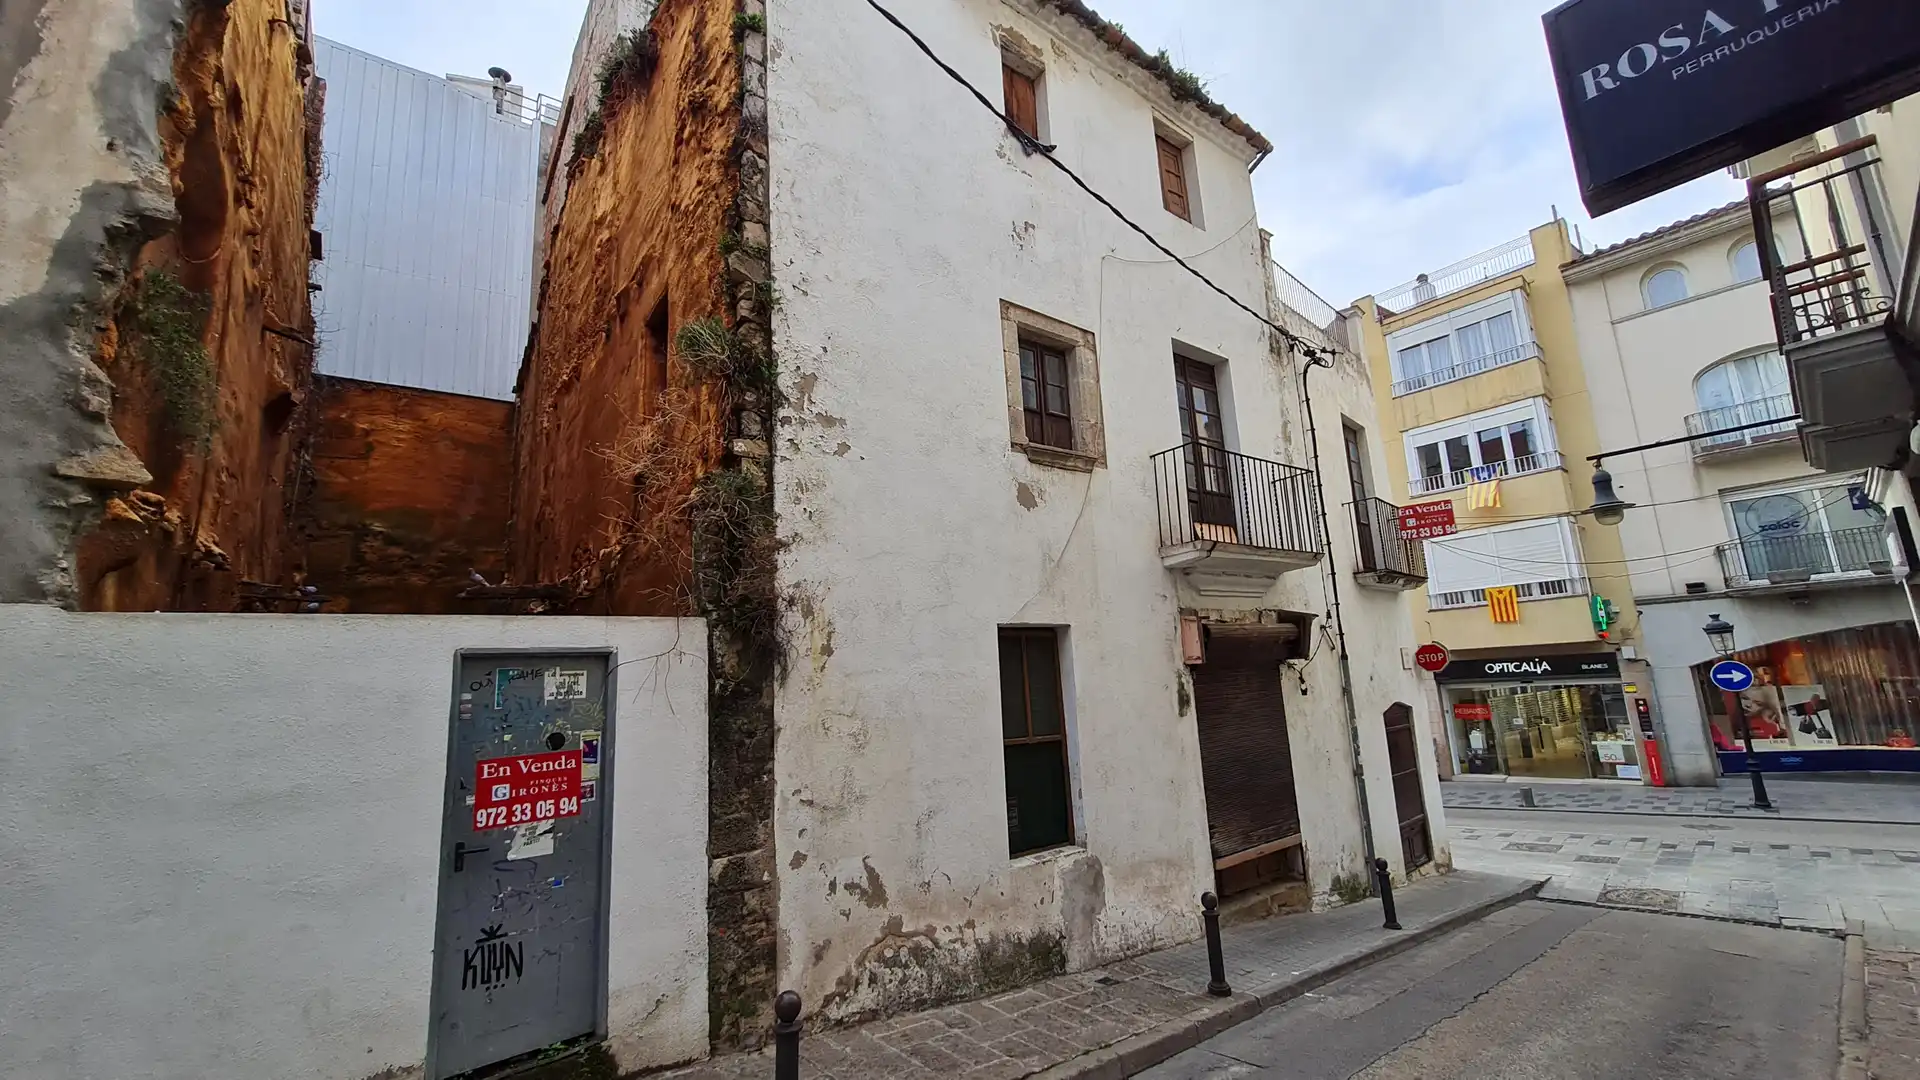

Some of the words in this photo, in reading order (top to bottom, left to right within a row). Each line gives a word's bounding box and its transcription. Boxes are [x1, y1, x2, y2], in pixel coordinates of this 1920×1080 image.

[1672, 0, 1840, 80] PERRUQUERIA
[1580, 9, 1738, 101] ROSA
[1399, 508, 1413, 516] En
[1416, 502, 1452, 513] Venda
[1401, 530, 1418, 539] 972
[1420, 527, 1430, 537] 33
[1432, 526, 1443, 535] 05
[1445, 524, 1456, 533] 94
[1418, 652, 1444, 663] STOP
[481, 763, 511, 779] En
[516, 755, 577, 774] Venda
[476, 806, 507, 828] 972
[511, 803, 531, 822] 33
[536, 800, 555, 818] 05
[559, 796, 578, 815] 94
